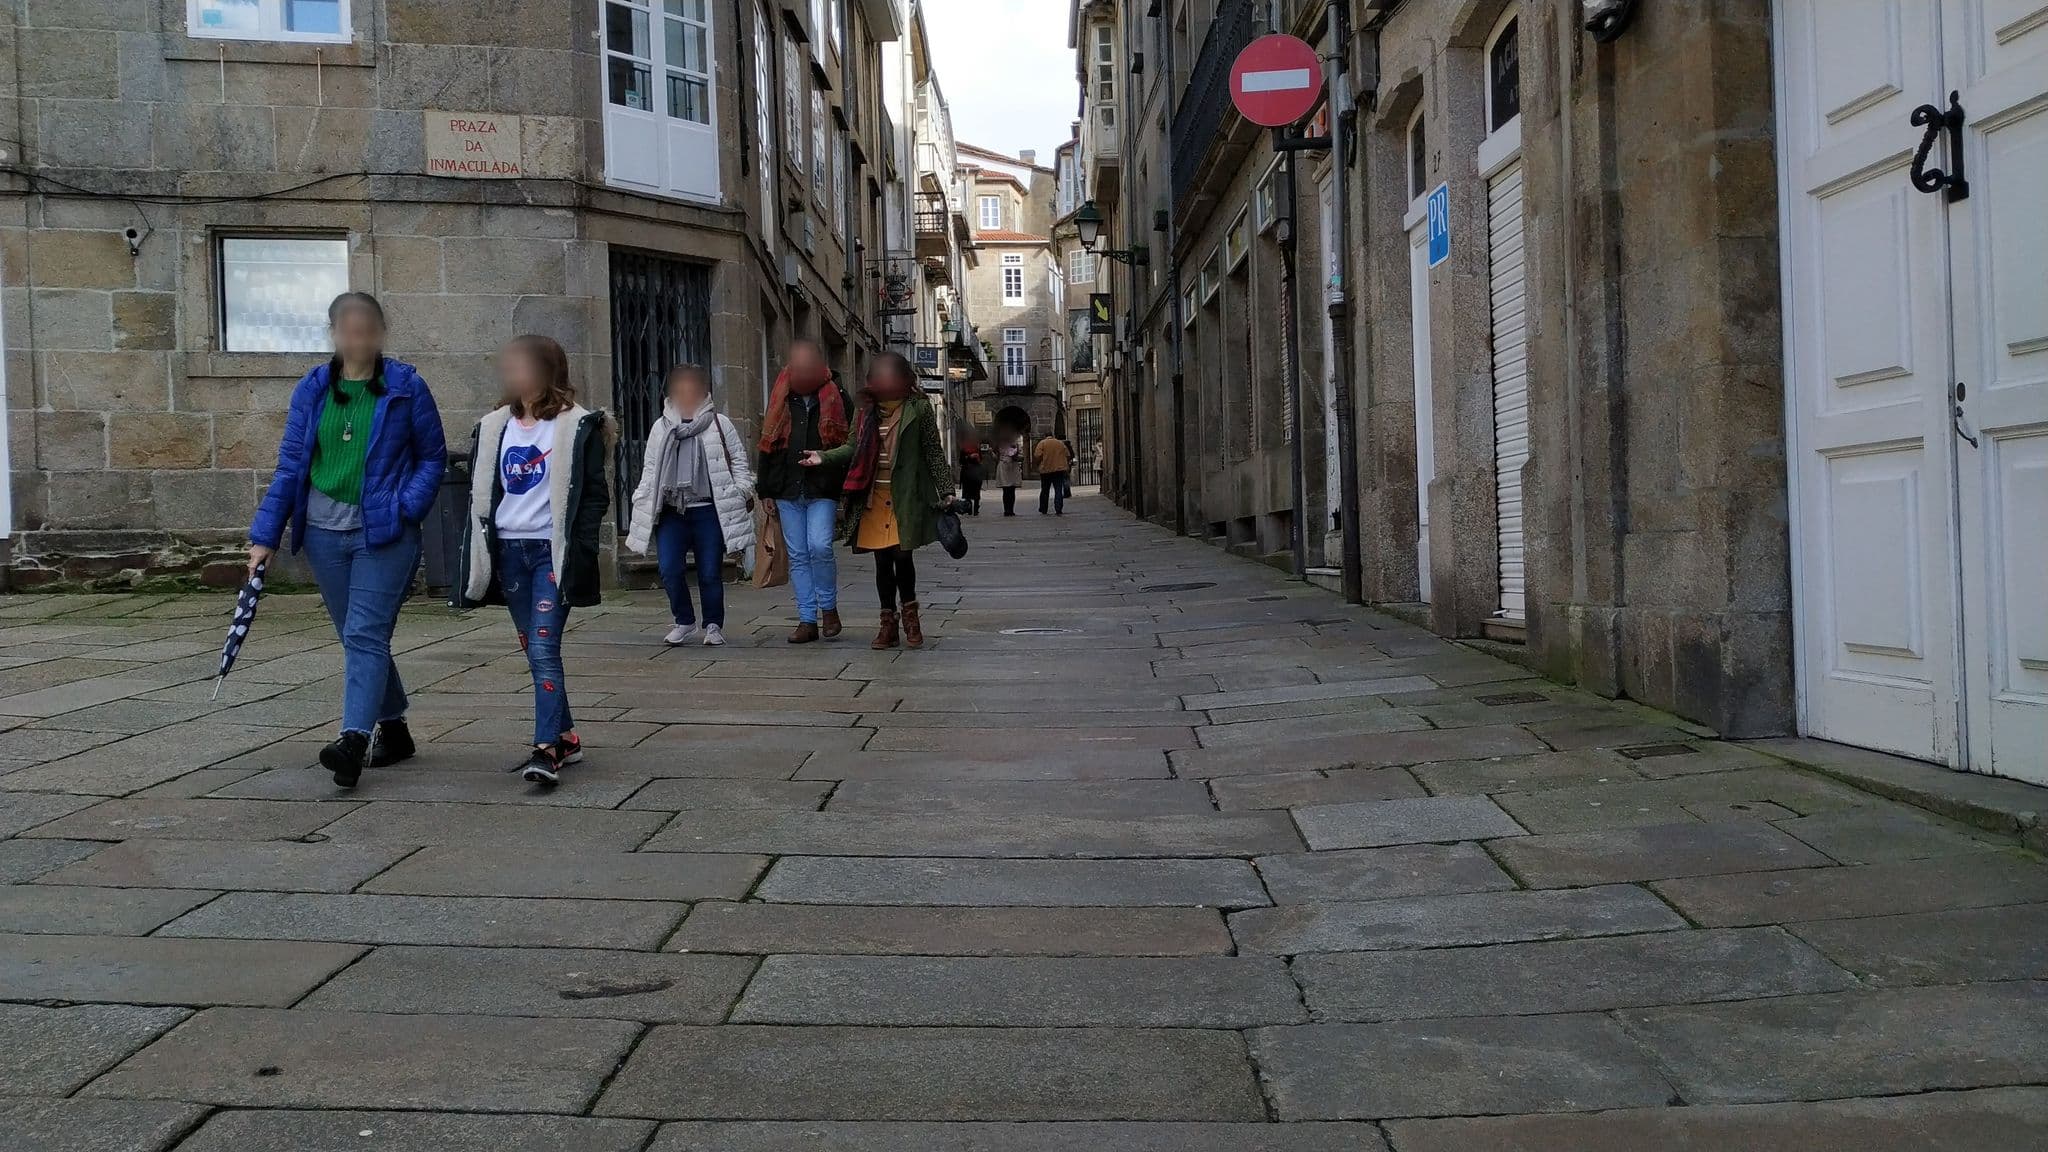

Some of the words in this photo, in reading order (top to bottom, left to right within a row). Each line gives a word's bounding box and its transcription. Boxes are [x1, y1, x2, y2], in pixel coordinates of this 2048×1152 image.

[450, 119, 497, 133] PRAZA
[464, 139, 484, 152] DA
[430, 158, 520, 174] INMACULADA
[1429, 191, 1447, 242] PR
[505, 463, 543, 475] NASA
